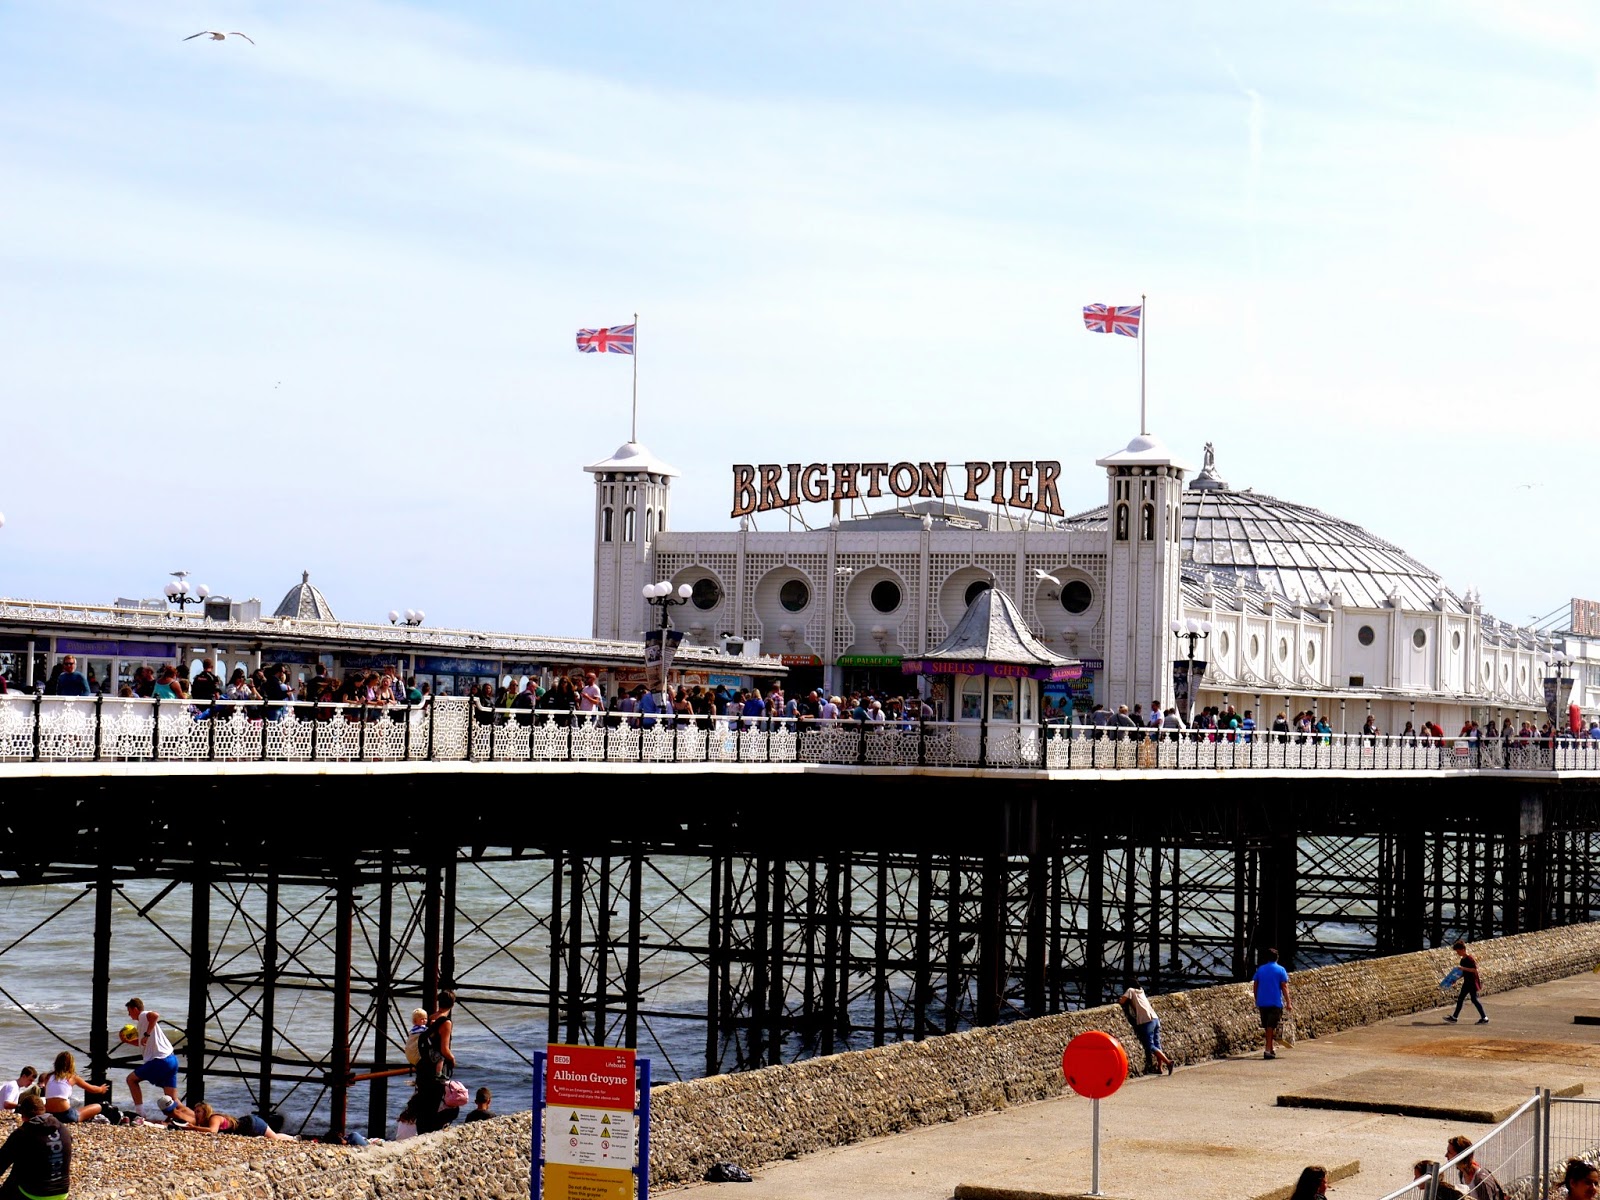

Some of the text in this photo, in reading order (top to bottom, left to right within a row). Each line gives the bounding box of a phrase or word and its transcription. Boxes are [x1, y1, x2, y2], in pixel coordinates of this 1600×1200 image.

[731, 460, 1064, 518] BRIGHTON PIER
[841, 657, 853, 665] THE
[856, 657, 882, 665] PALACE
[1086, 661, 1102, 669] PRIZES
[932, 662, 975, 673] SHELLS
[994, 664, 1029, 676] GIFTS
[553, 1070, 628, 1086] Albion Groyne
